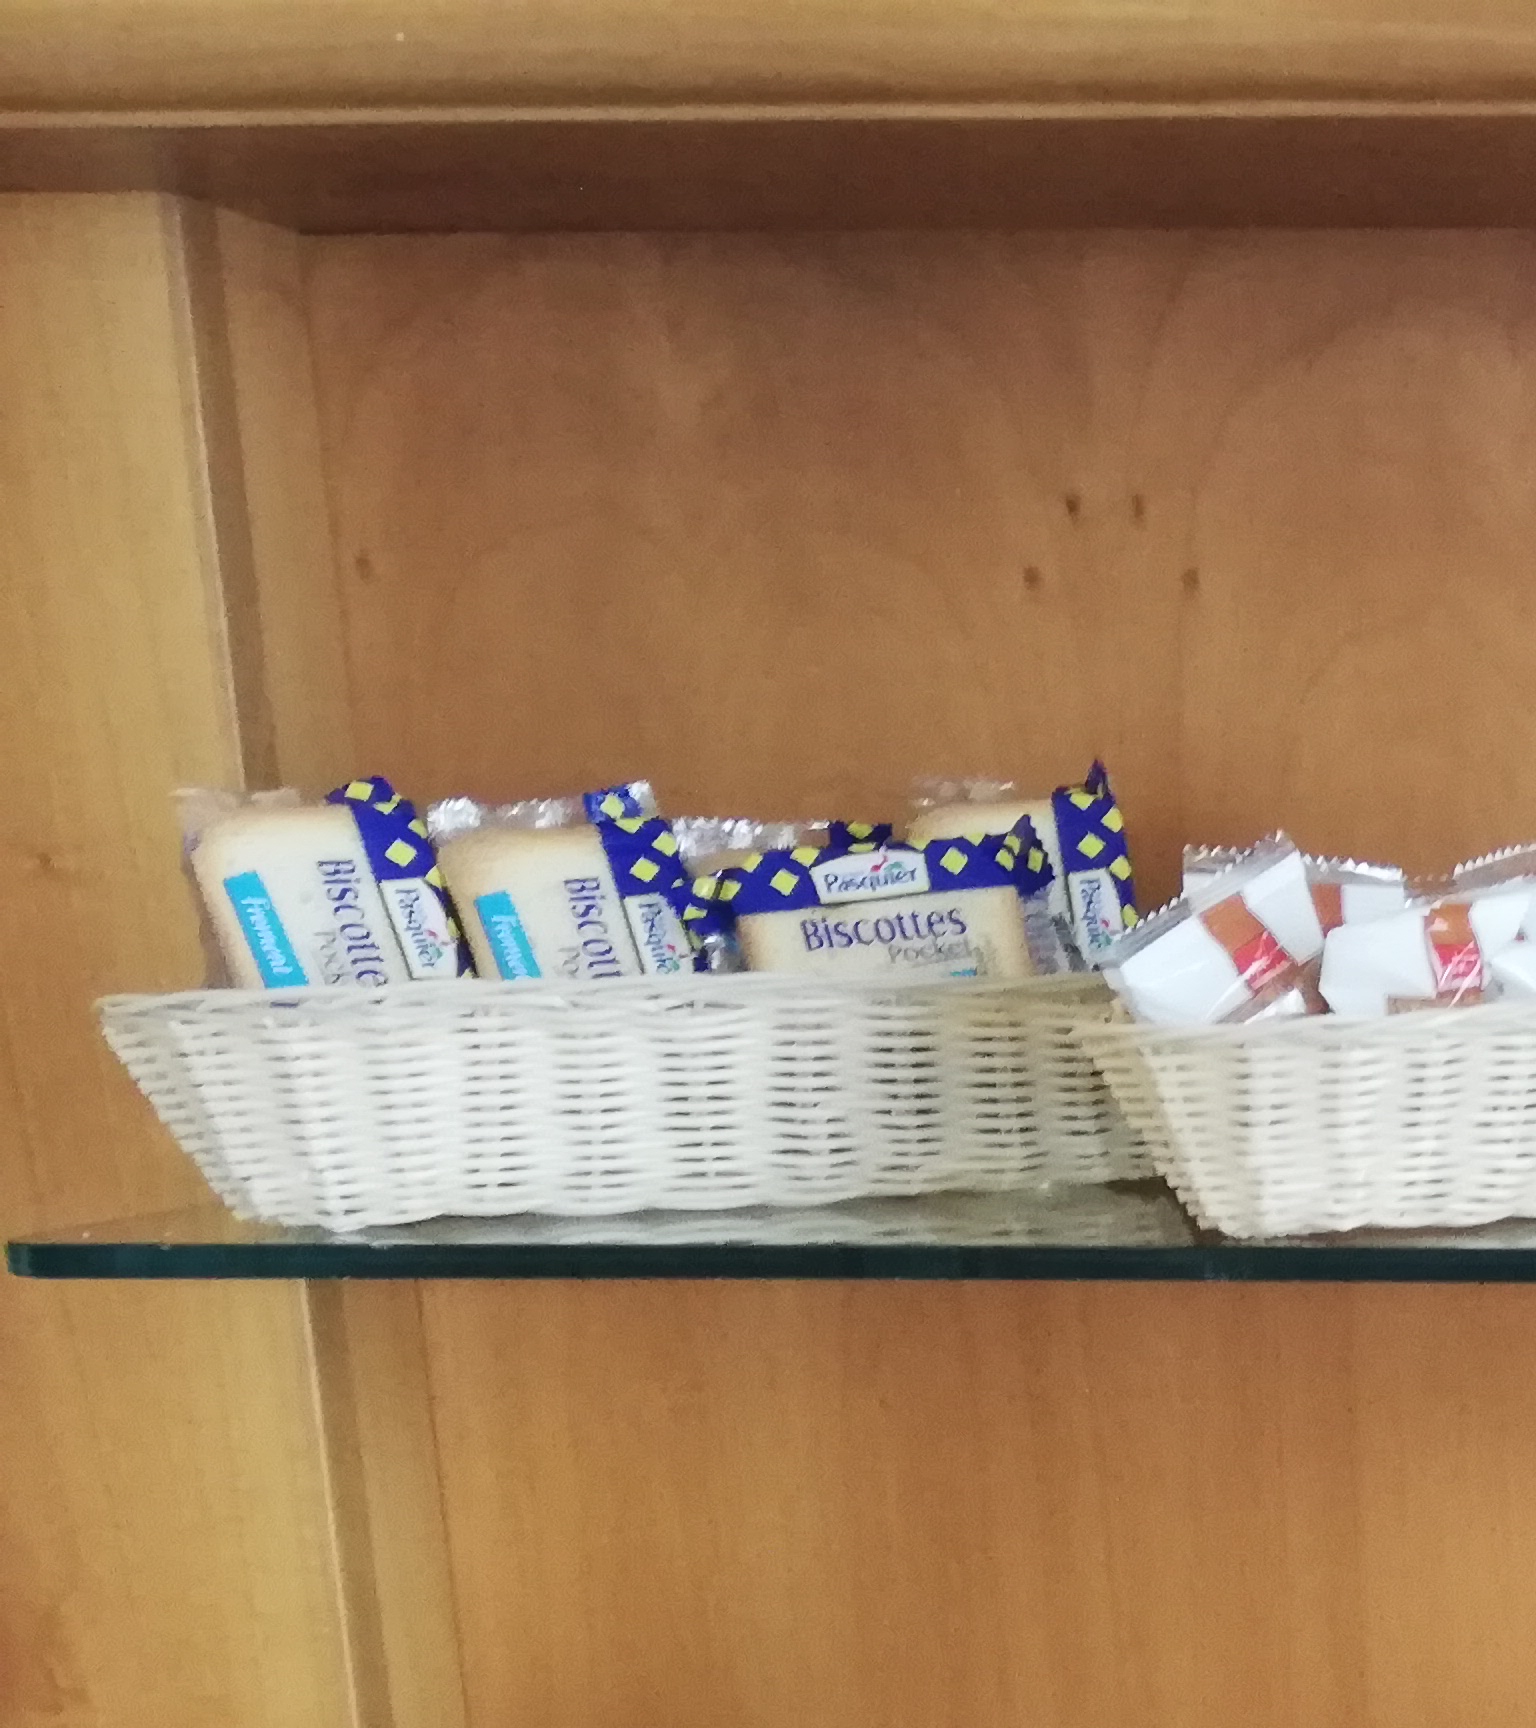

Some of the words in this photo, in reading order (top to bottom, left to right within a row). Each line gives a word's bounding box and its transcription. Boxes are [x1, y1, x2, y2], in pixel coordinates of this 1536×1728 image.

[823, 866, 918, 894] Pasquier
[316, 859, 389, 987] Biscotte
[563, 877, 623, 979] Biscott
[638, 902, 677, 975] Pasquie
[801, 907, 967, 952] Biscottes
